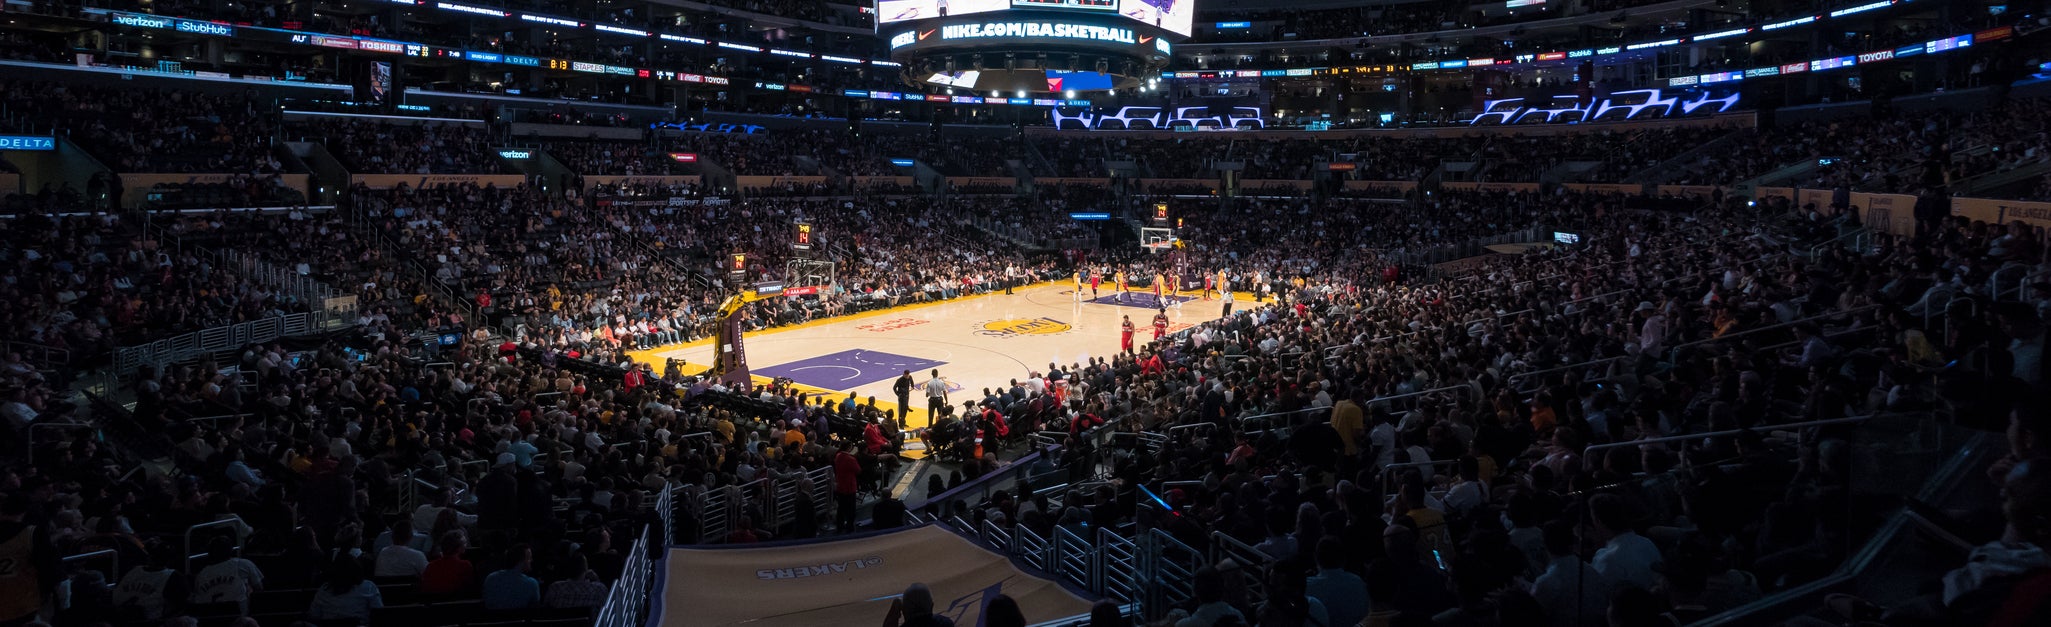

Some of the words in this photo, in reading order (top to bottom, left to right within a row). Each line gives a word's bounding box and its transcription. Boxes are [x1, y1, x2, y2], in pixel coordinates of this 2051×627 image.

[118, 16, 163, 28] verizon
[182, 22, 226, 34] StubHub
[942, 22, 1135, 44] NIKE.COM/BASKETBALL
[360, 42, 403, 52] TOSHIBA
[1858, 51, 1893, 63] TOYOTA
[550, 59, 567, 70] 8:13
[574, 62, 604, 72] STAPLES
[704, 76, 728, 84] TOYOTA
[1670, 76, 1696, 85] STAPLES
[0, 138, 51, 147] DELTA
[800, 233, 808, 243] 14
[756, 556, 884, 580] @LAKERS
